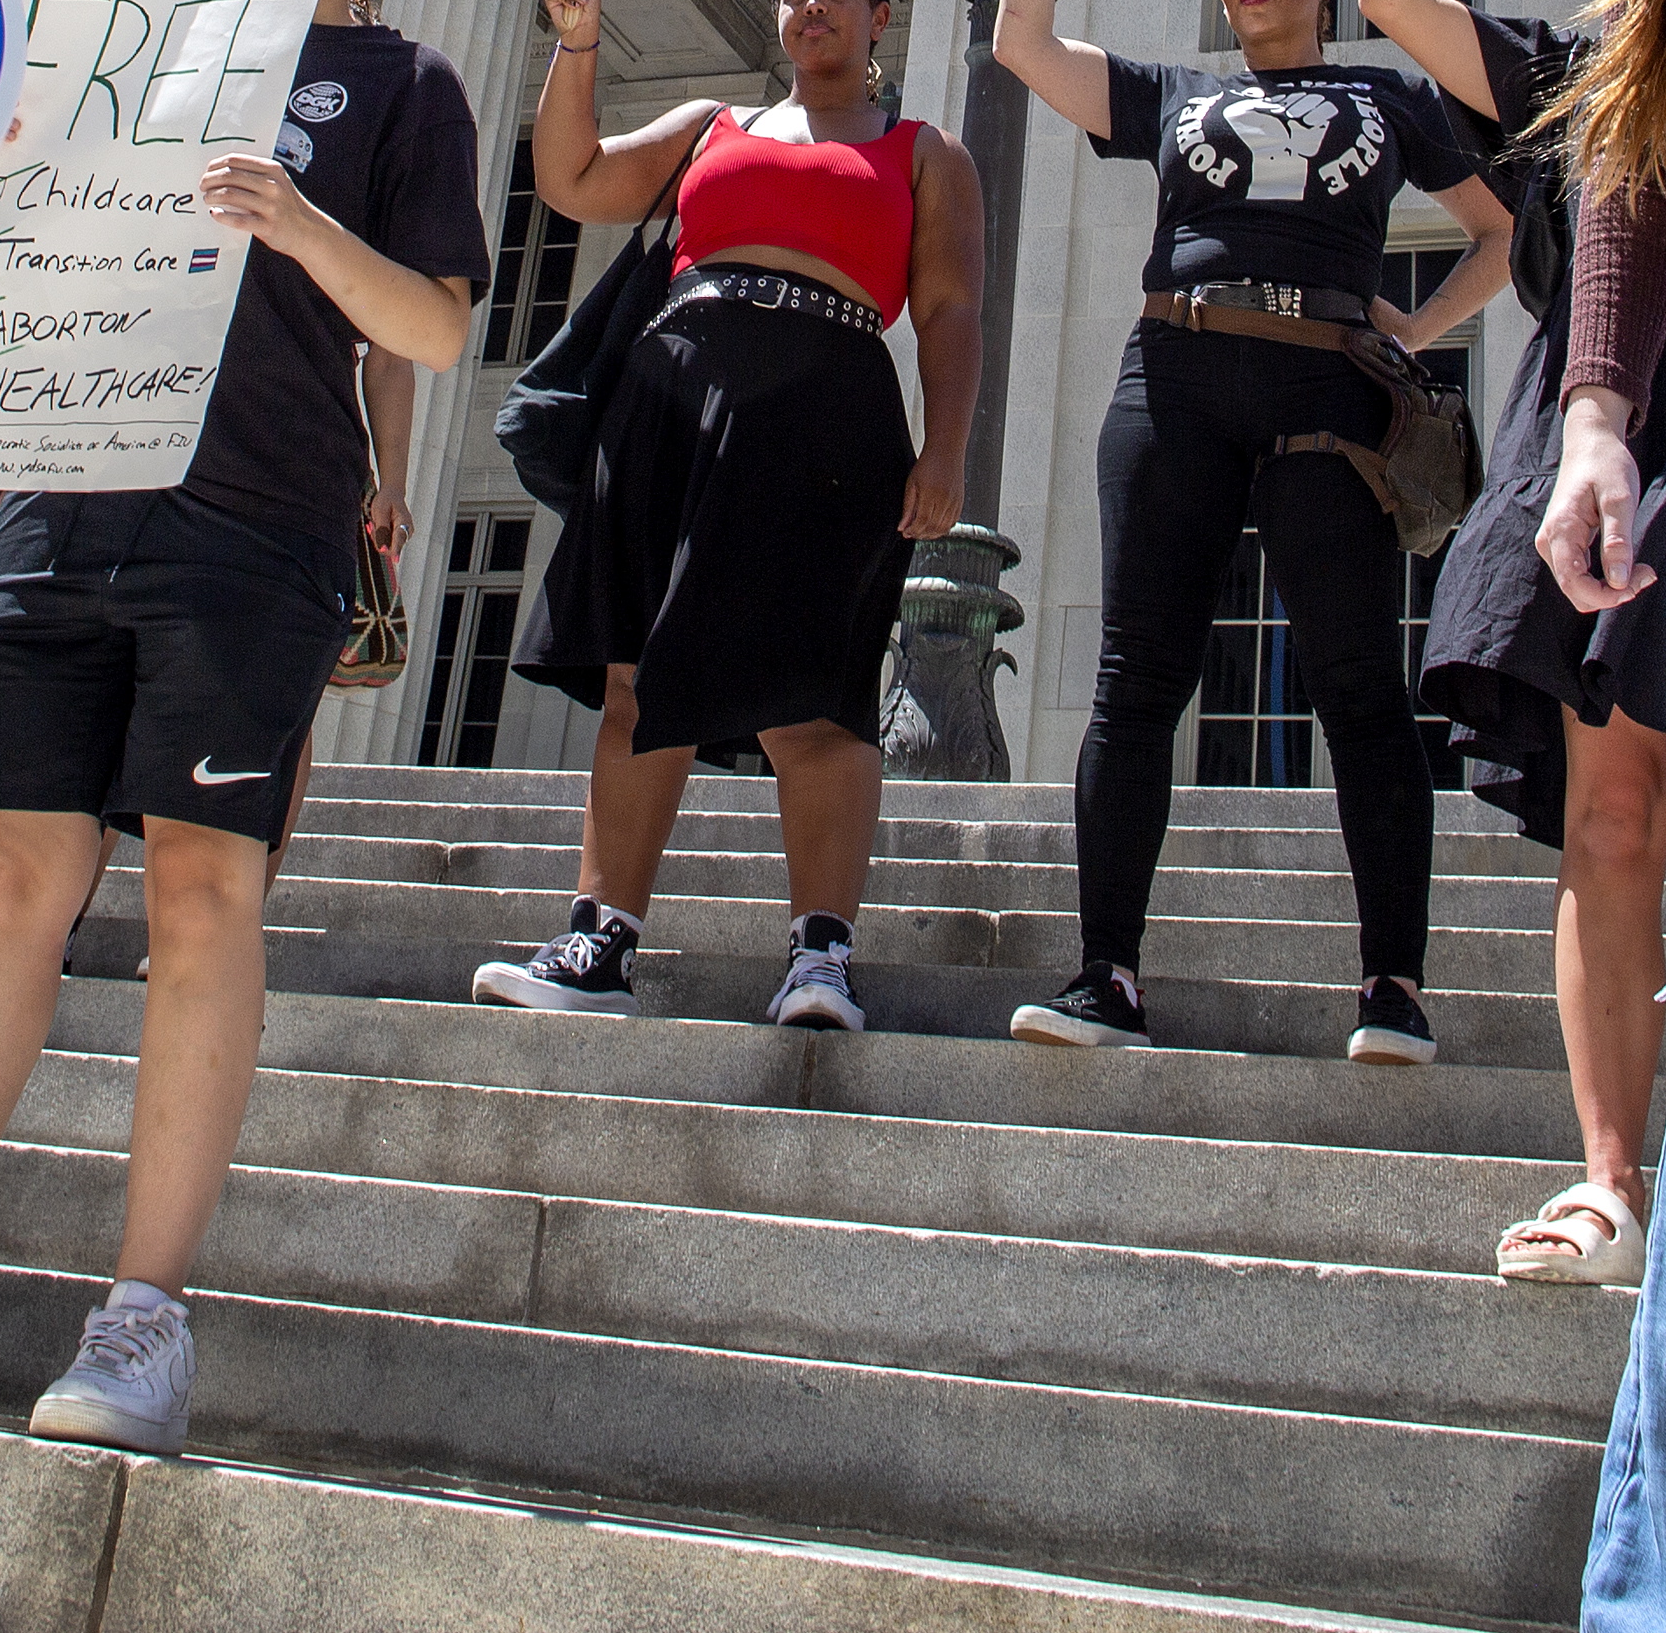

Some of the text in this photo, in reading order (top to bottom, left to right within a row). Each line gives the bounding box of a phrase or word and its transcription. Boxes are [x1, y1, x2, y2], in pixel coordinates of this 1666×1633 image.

[295, 91, 341, 113] DGK
[17, 165, 197, 215] Childcare
[133, 247, 178, 272] Care
[166, 432, 193, 449] FIU
